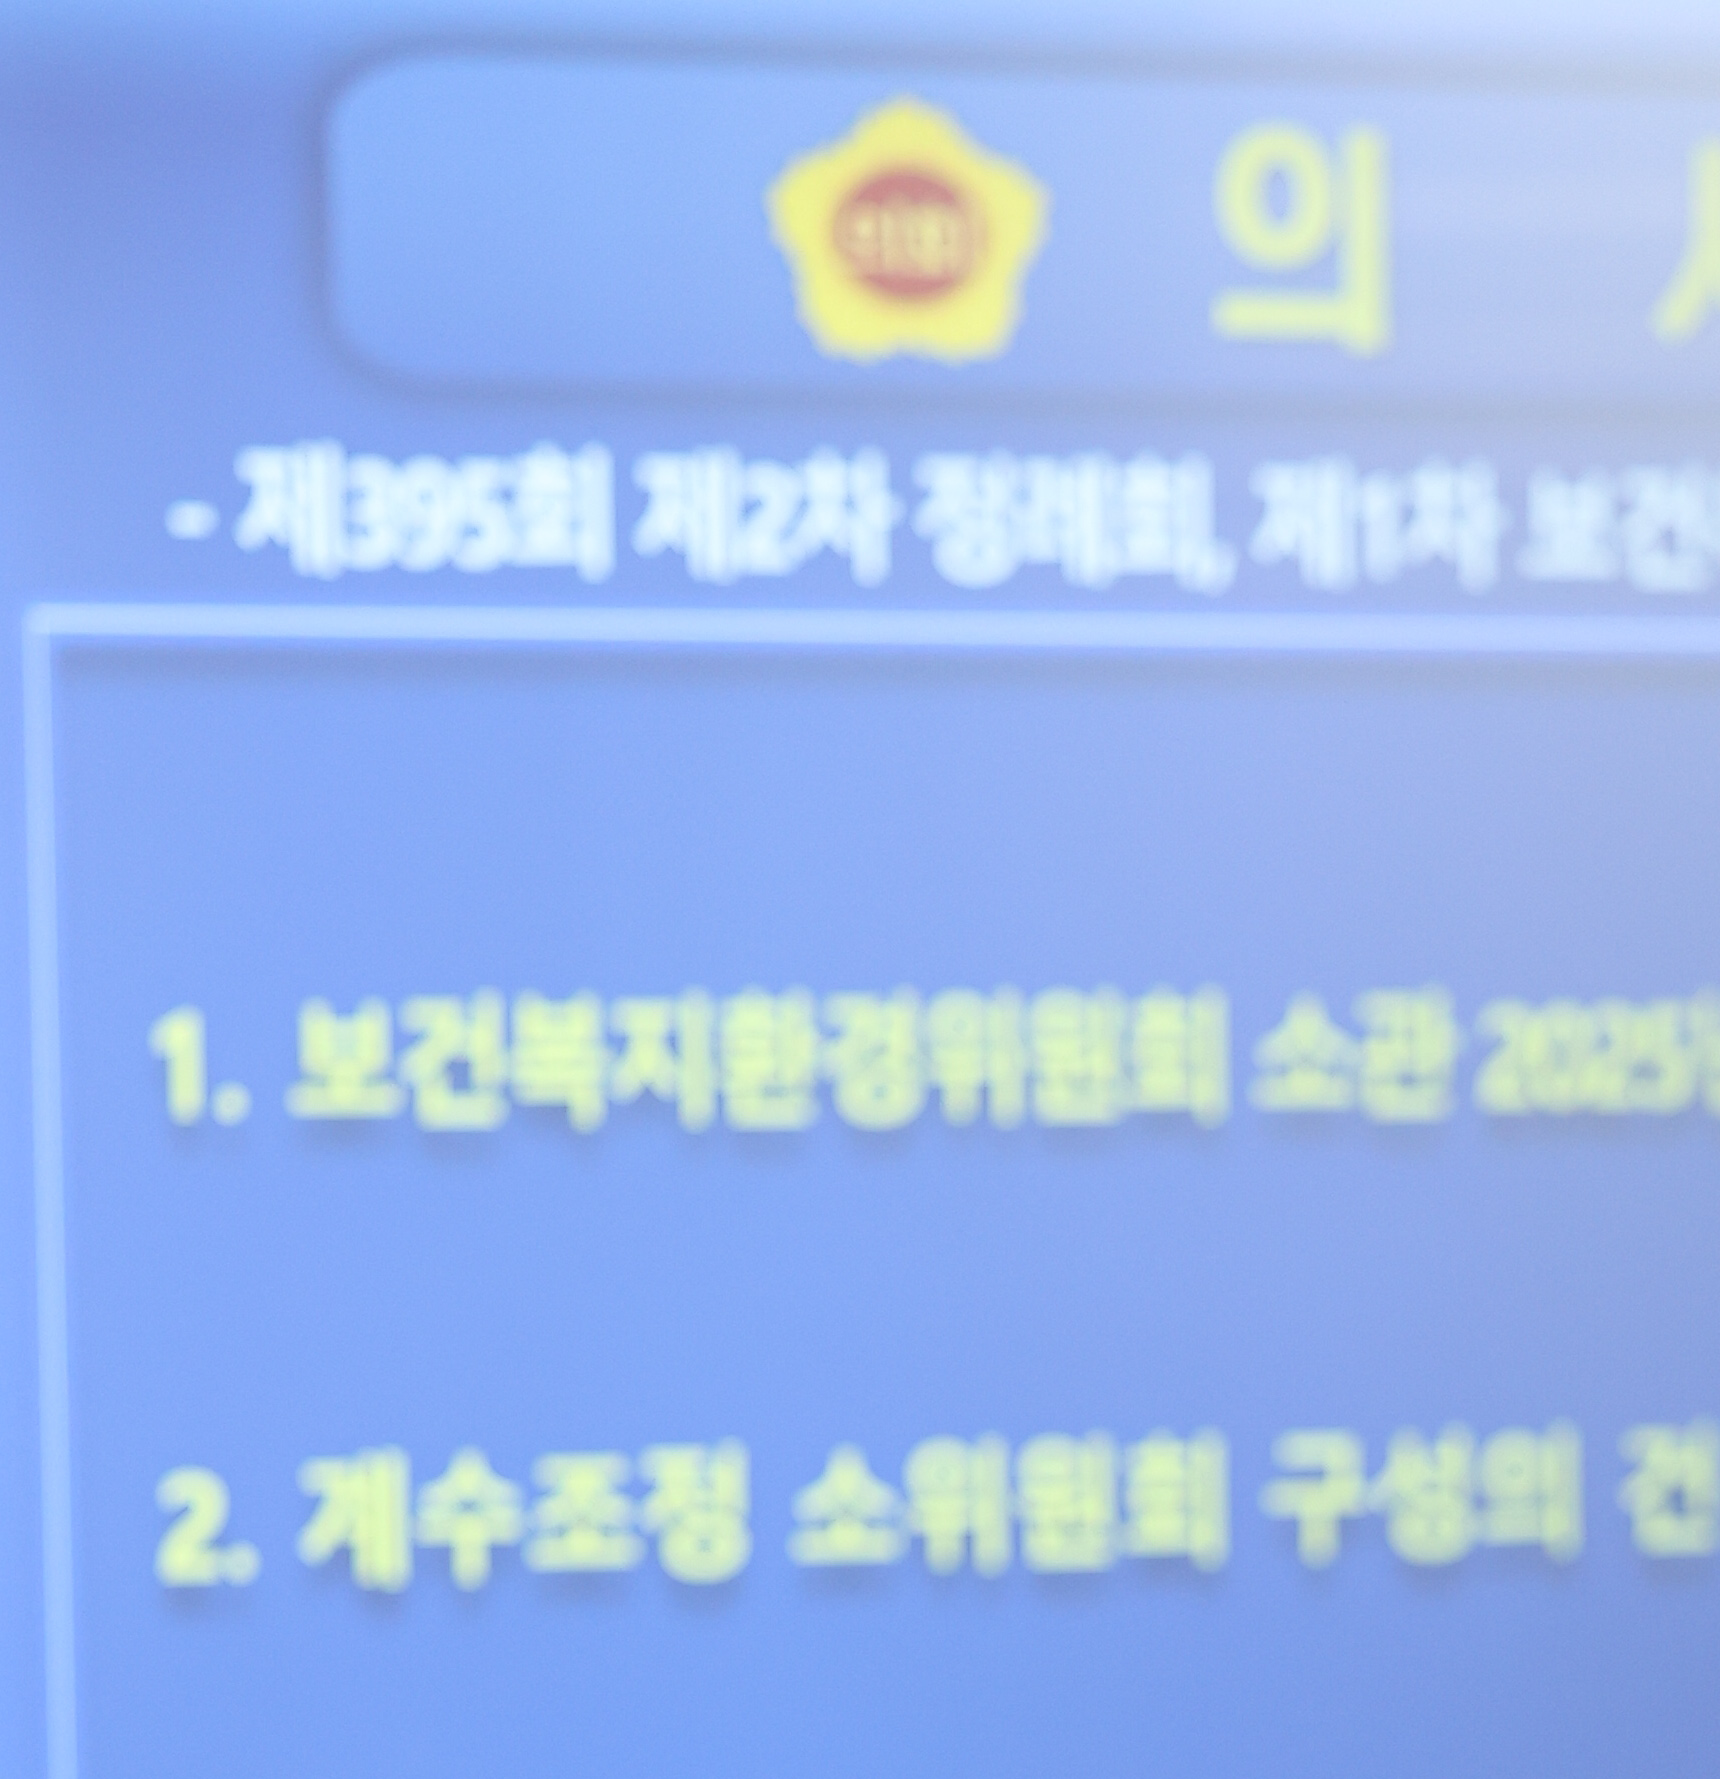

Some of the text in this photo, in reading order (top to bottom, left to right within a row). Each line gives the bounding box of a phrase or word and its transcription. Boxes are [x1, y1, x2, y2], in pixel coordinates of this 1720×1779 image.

[239, 442, 610, 577] 제395회
[637, 447, 899, 581] 제2차
[917, 452, 1231, 588] 정례회,
[1254, 460, 1502, 589] 제1차
[154, 1008, 246, 1122] 1.
[290, 987, 1226, 1130] 보건복지환경위원회
[1252, 987, 1453, 1120] 소관
[158, 1471, 258, 1586] 2.
[299, 1440, 747, 1591] 계수조정
[790, 1432, 1226, 1578] 소위원회
[1263, 1421, 1580, 1569] 구성의
